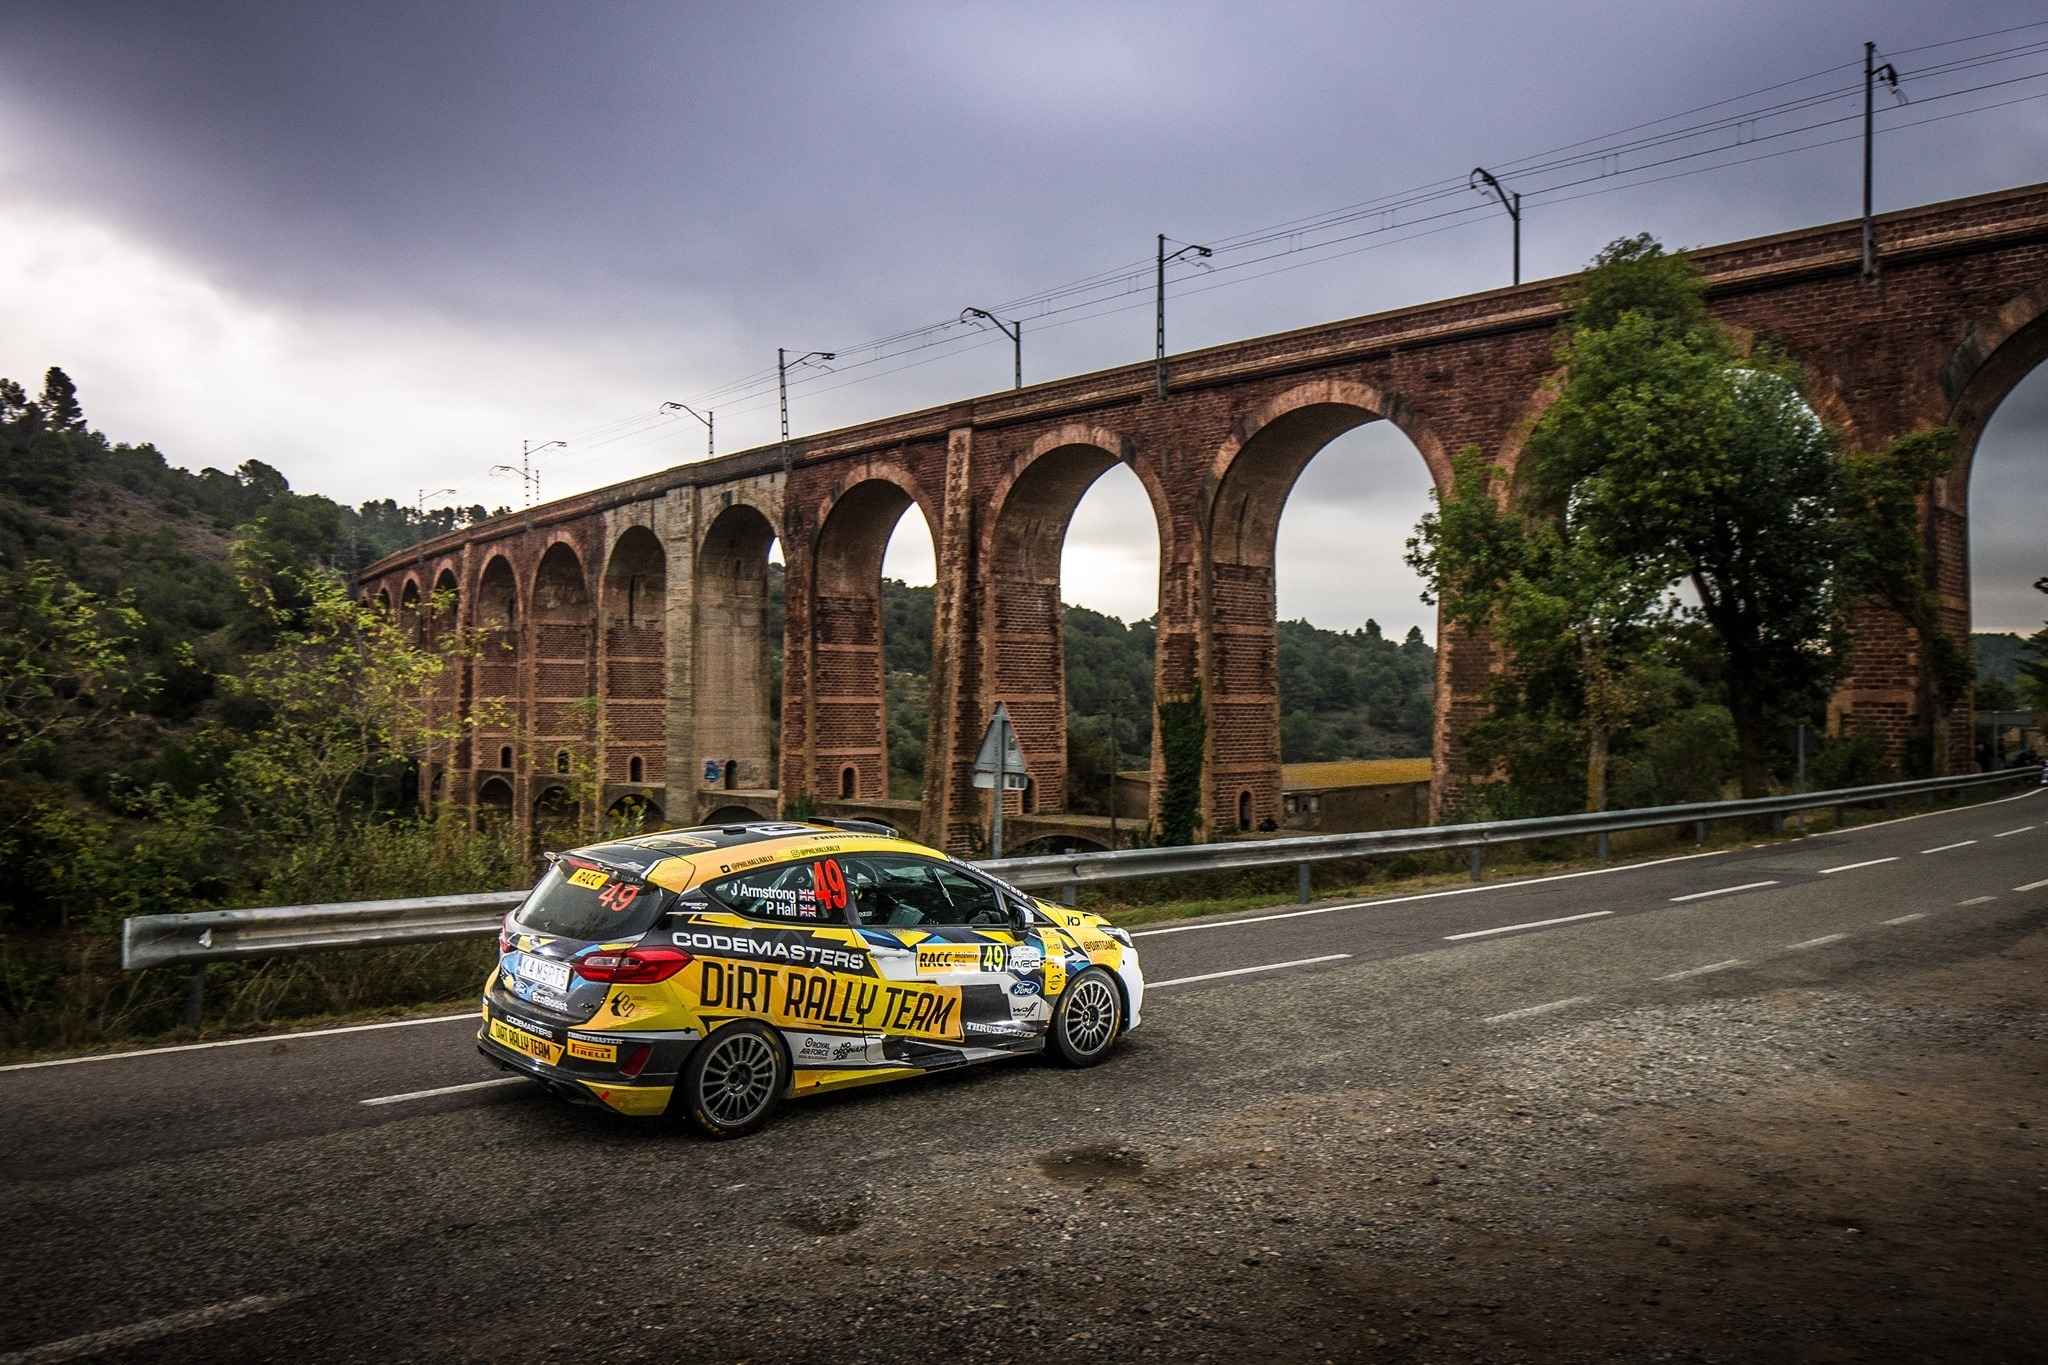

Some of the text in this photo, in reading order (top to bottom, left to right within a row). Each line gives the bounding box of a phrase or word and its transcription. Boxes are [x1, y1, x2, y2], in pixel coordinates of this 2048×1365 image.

[730, 883, 796, 904] J Armstrong
[812, 857, 848, 911] 49
[598, 881, 639, 912] 49
[766, 901, 797, 917] P Hall
[671, 931, 865, 970] CODEMASTERS
[919, 952, 952, 968] RACC
[982, 945, 1003, 973] 49
[1010, 959, 1040, 969] WRC
[1013, 981, 1036, 995] Ford
[532, 991, 568, 1011] EcoBoost
[783, 972, 878, 1025] RALLY
[880, 986, 957, 1035] TEAM
[506, 1014, 553, 1039] CODEMASTERS
[509, 1029, 530, 1053] RALLY
[530, 1038, 552, 1061] TEAM
[571, 1043, 612, 1060] PIRELLI
